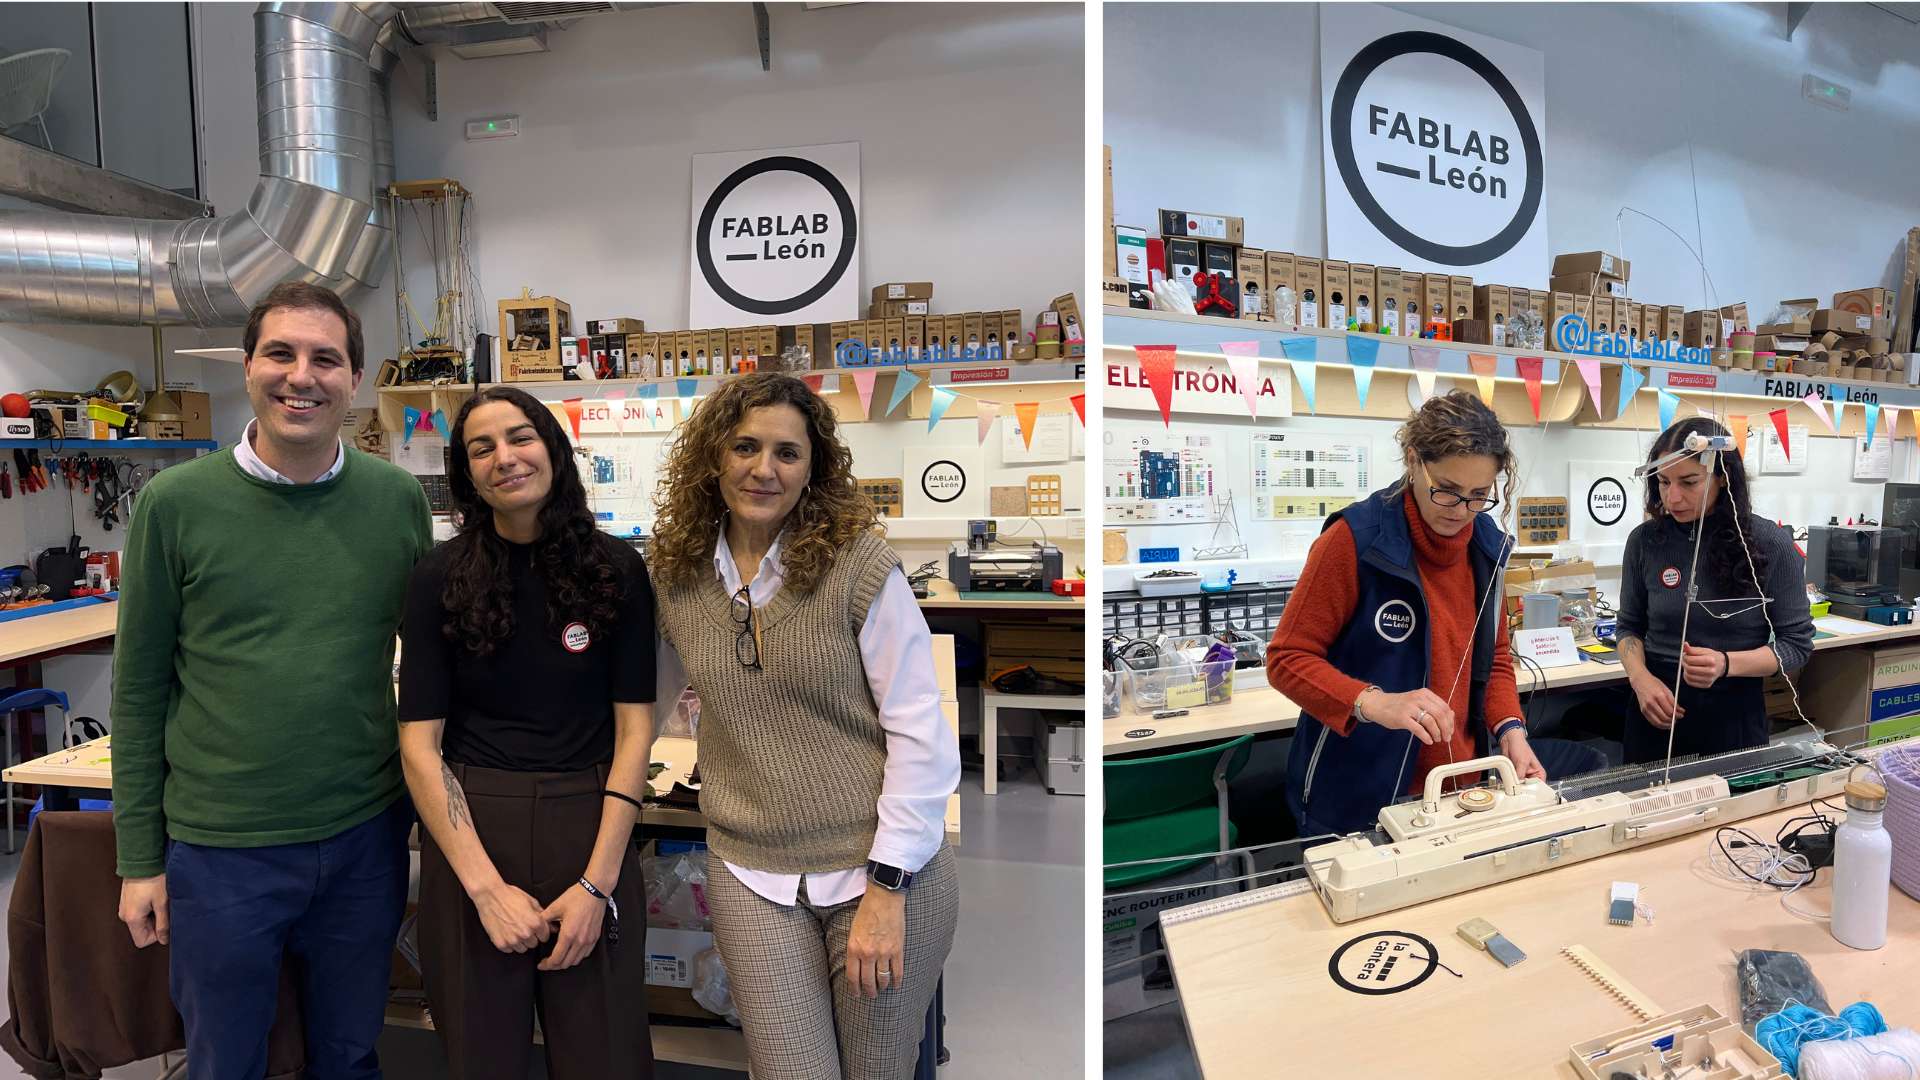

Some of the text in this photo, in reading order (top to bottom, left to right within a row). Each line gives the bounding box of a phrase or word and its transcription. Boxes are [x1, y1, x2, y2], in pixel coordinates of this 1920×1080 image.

[1369, 104, 1509, 165] FABLAB
[1428, 154, 1507, 199] León
[722, 213, 829, 238] FABLAB
[763, 238, 825, 260] León
[1556, 314, 1712, 366] @FabLabLeon
[836, 338, 1003, 368] @FabLabLeon
[1107, 364, 1276, 397] ELETRÓNA
[1846, 386, 1878, 404] León
[1593, 494, 1621, 502] FABLAB
[1604, 501, 1621, 509] León
[1382, 613, 1410, 623] FABLAB
[1393, 620, 1409, 629] León
[1879, 693, 1920, 708] CABLES
[1129, 892, 1185, 913] ROUTER
[1187, 886, 1209, 898] KIT
[1393, 942, 1410, 951] la
[1356, 940, 1390, 980] cantera
